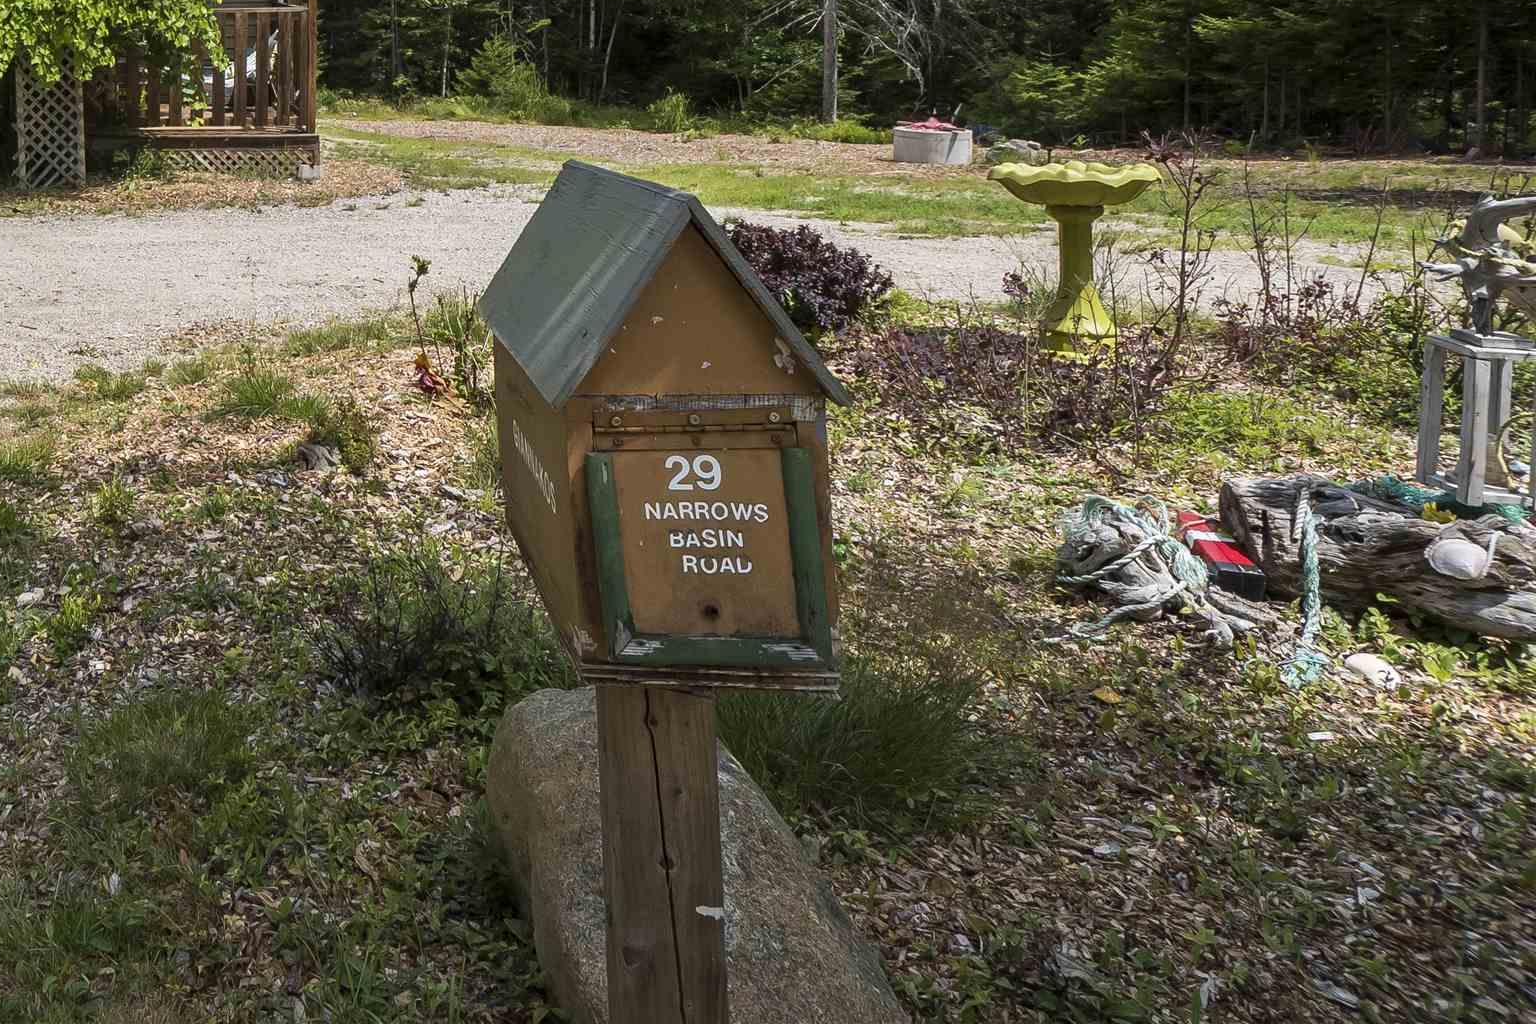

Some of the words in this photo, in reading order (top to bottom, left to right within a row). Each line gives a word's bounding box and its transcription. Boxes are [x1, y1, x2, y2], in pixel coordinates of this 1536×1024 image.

[664, 454, 722, 491] 29
[644, 501, 769, 523] NARROWS
[669, 528, 744, 548] BASIN
[682, 554, 753, 574] ROAD
